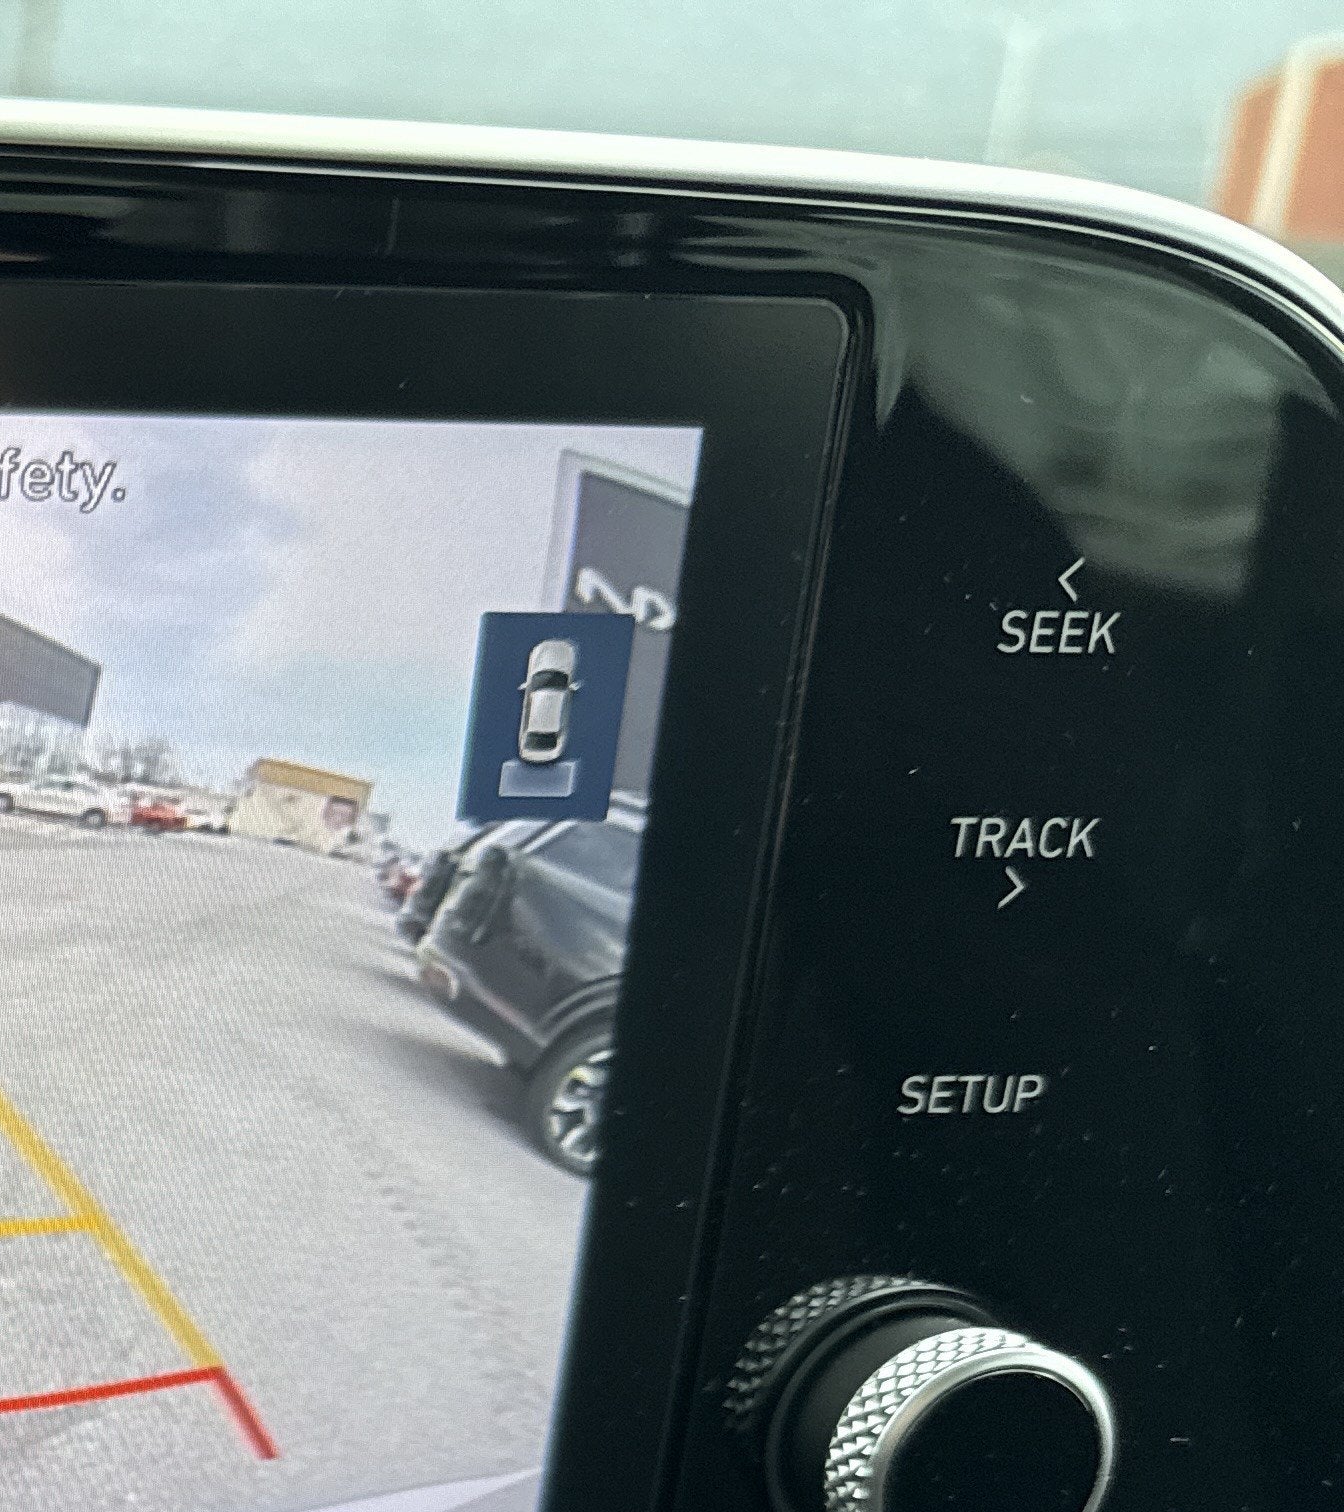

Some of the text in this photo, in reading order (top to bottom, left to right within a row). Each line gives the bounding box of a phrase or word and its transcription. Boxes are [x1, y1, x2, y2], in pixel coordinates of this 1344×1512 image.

[996, 610, 1122, 655] SEEK
[950, 816, 1102, 859] TRACK
[896, 1073, 1046, 1117] SETUP
